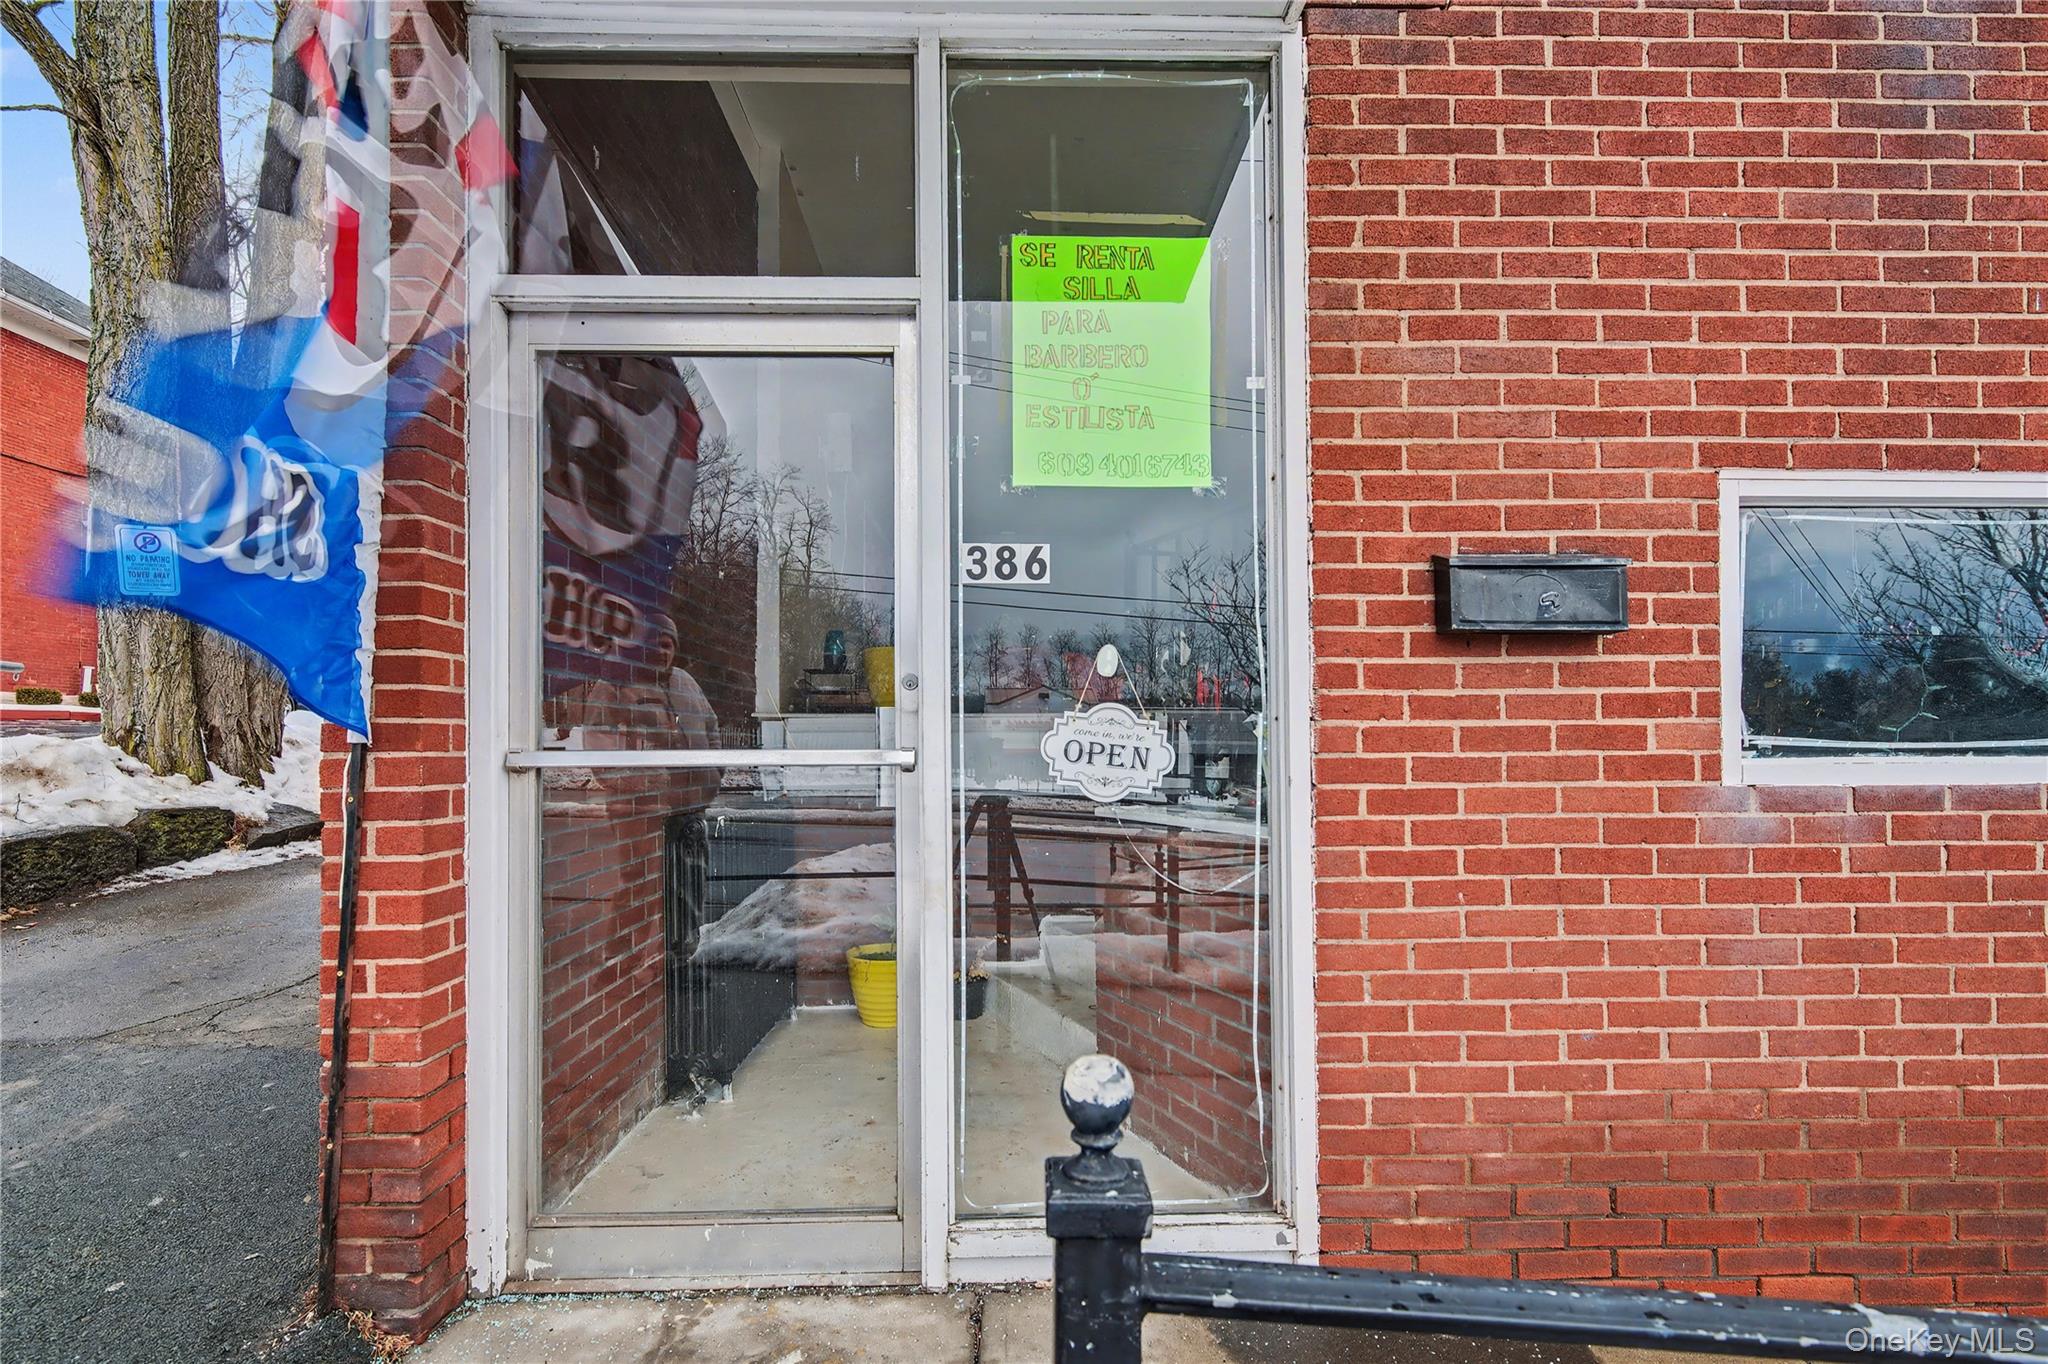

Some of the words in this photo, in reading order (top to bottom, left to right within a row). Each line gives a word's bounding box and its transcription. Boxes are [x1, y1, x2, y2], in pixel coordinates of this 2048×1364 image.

[1019, 242, 1056, 267] SE
[1076, 243, 1155, 270] RENTA
[1063, 276, 1141, 300] SILLA
[1041, 309, 1112, 335] PARA
[1024, 344, 1149, 369] BARBERO
[1024, 404, 1155, 430] ESTILISTA
[125, 554, 137, 562] NO
[140, 555, 171, 564] PARKING
[966, 545, 1048, 581] 386
[1073, 728, 1100, 738] come
[1063, 739, 1150, 771] OPEN
